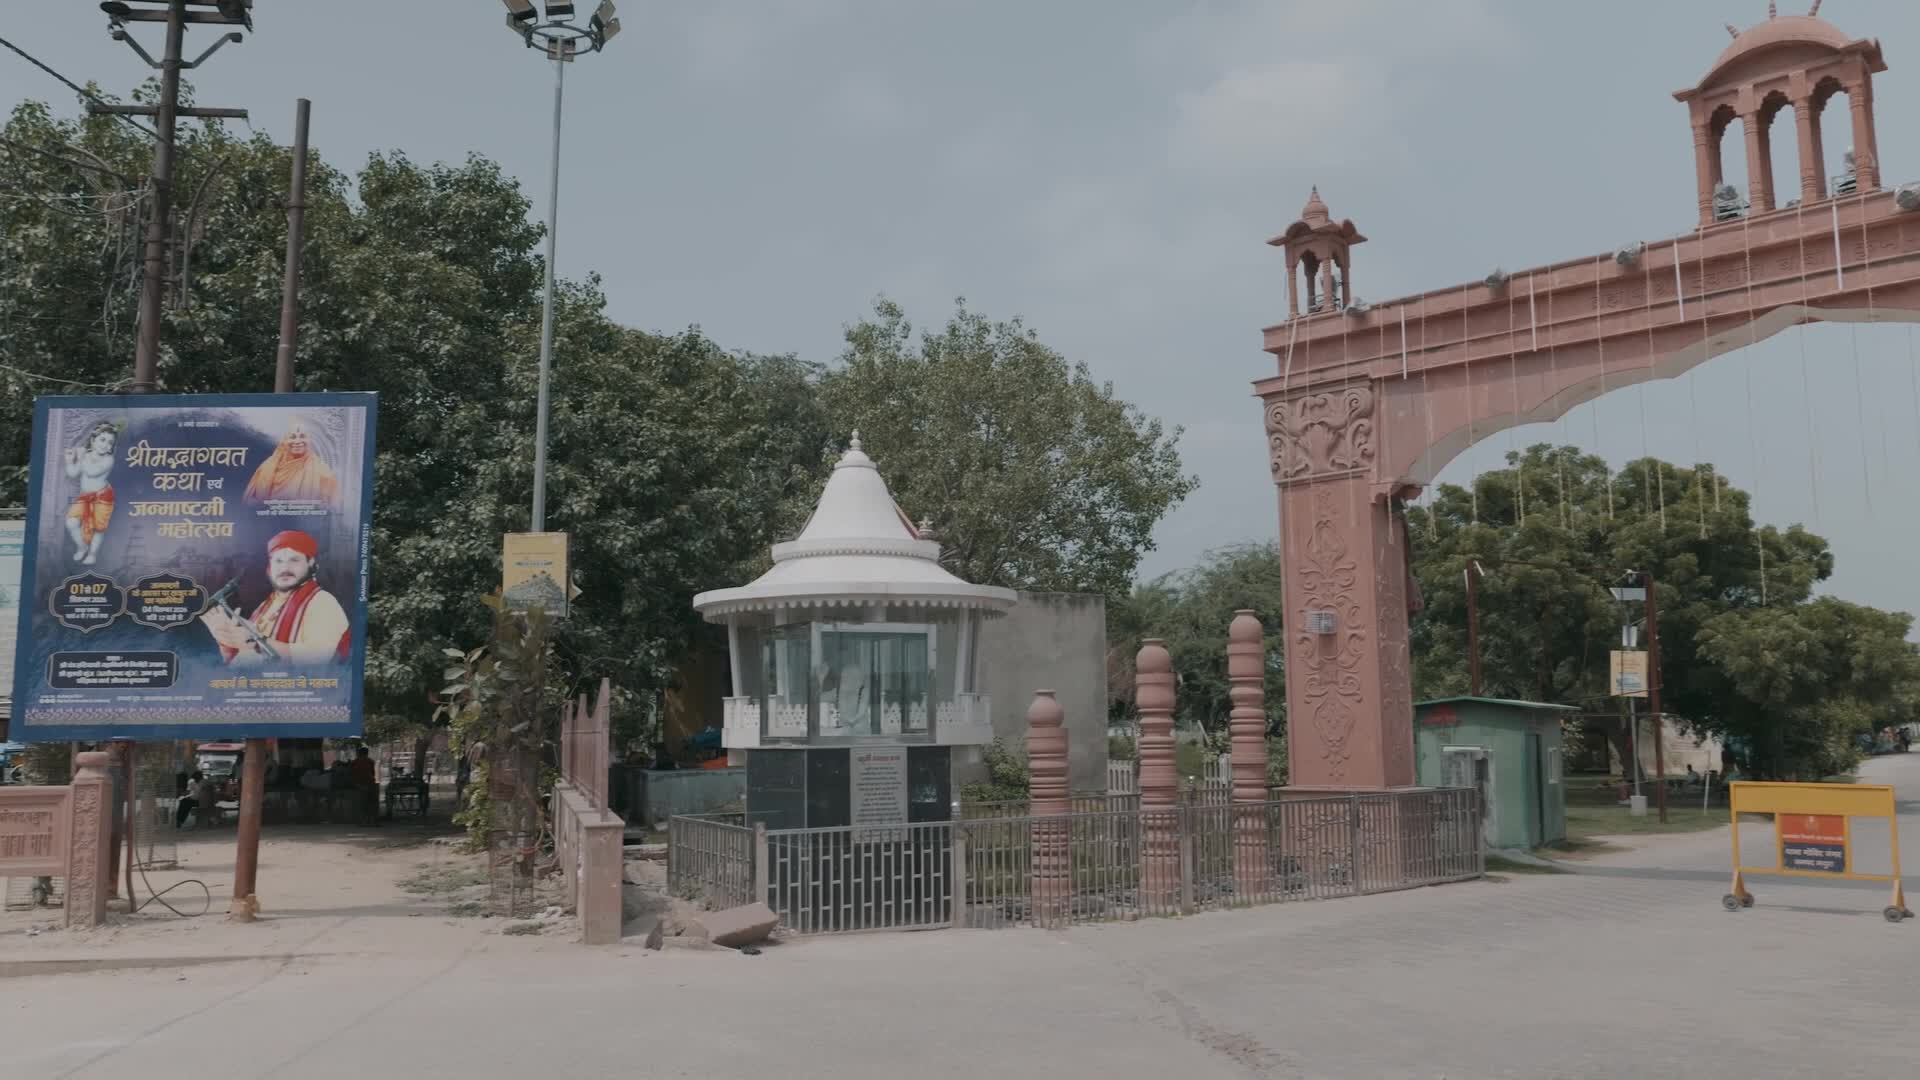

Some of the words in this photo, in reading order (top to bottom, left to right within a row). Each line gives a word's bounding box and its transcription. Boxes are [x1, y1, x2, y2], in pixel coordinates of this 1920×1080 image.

[126, 440, 249, 469] श्रीमद्भागवत
[153, 472, 205, 491] कथा
[207, 477, 224, 489] एवं
[128, 496, 226, 517] जन्माष्टमी
[158, 518, 235, 538] महोत्सव
[70, 583, 83, 594] 01
[92, 583, 107, 594] 07
